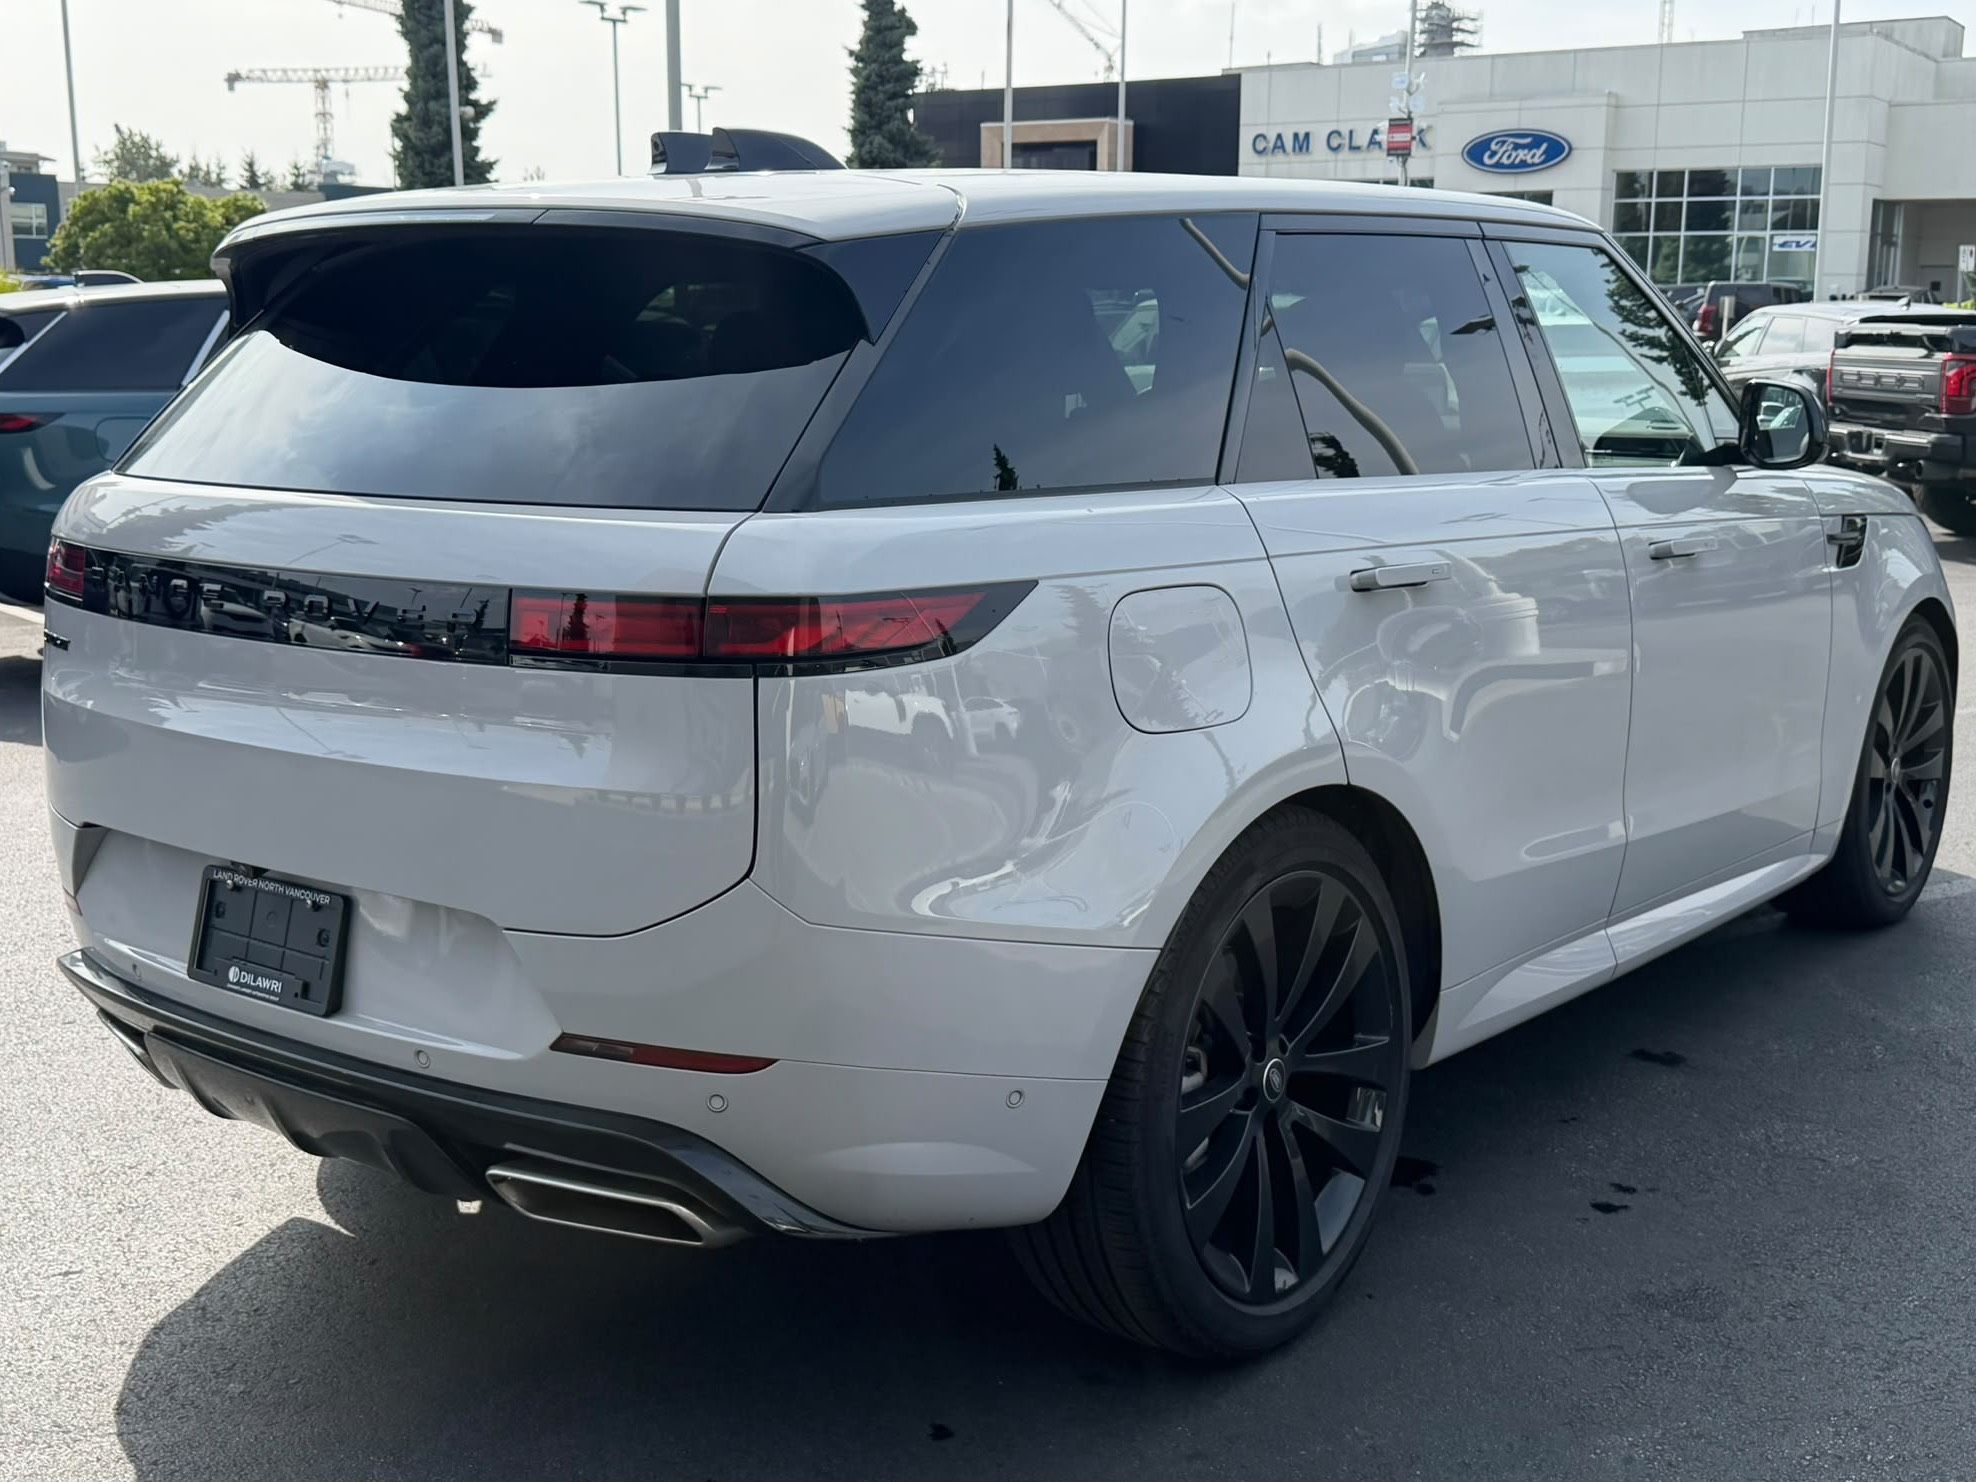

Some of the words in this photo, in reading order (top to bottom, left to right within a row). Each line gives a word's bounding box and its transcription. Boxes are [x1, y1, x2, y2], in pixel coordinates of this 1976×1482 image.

[1252, 131, 1311, 154] CAM
[1326, 125, 1432, 152] CLAK
[1483, 137, 1548, 165] Ford
[213, 870, 234, 881] LAND
[234, 873, 258, 888] ROVER
[257, 880, 285, 894] NORTH
[285, 887, 330, 905] VANCOUVER
[240, 971, 282, 993] DILAWRI
